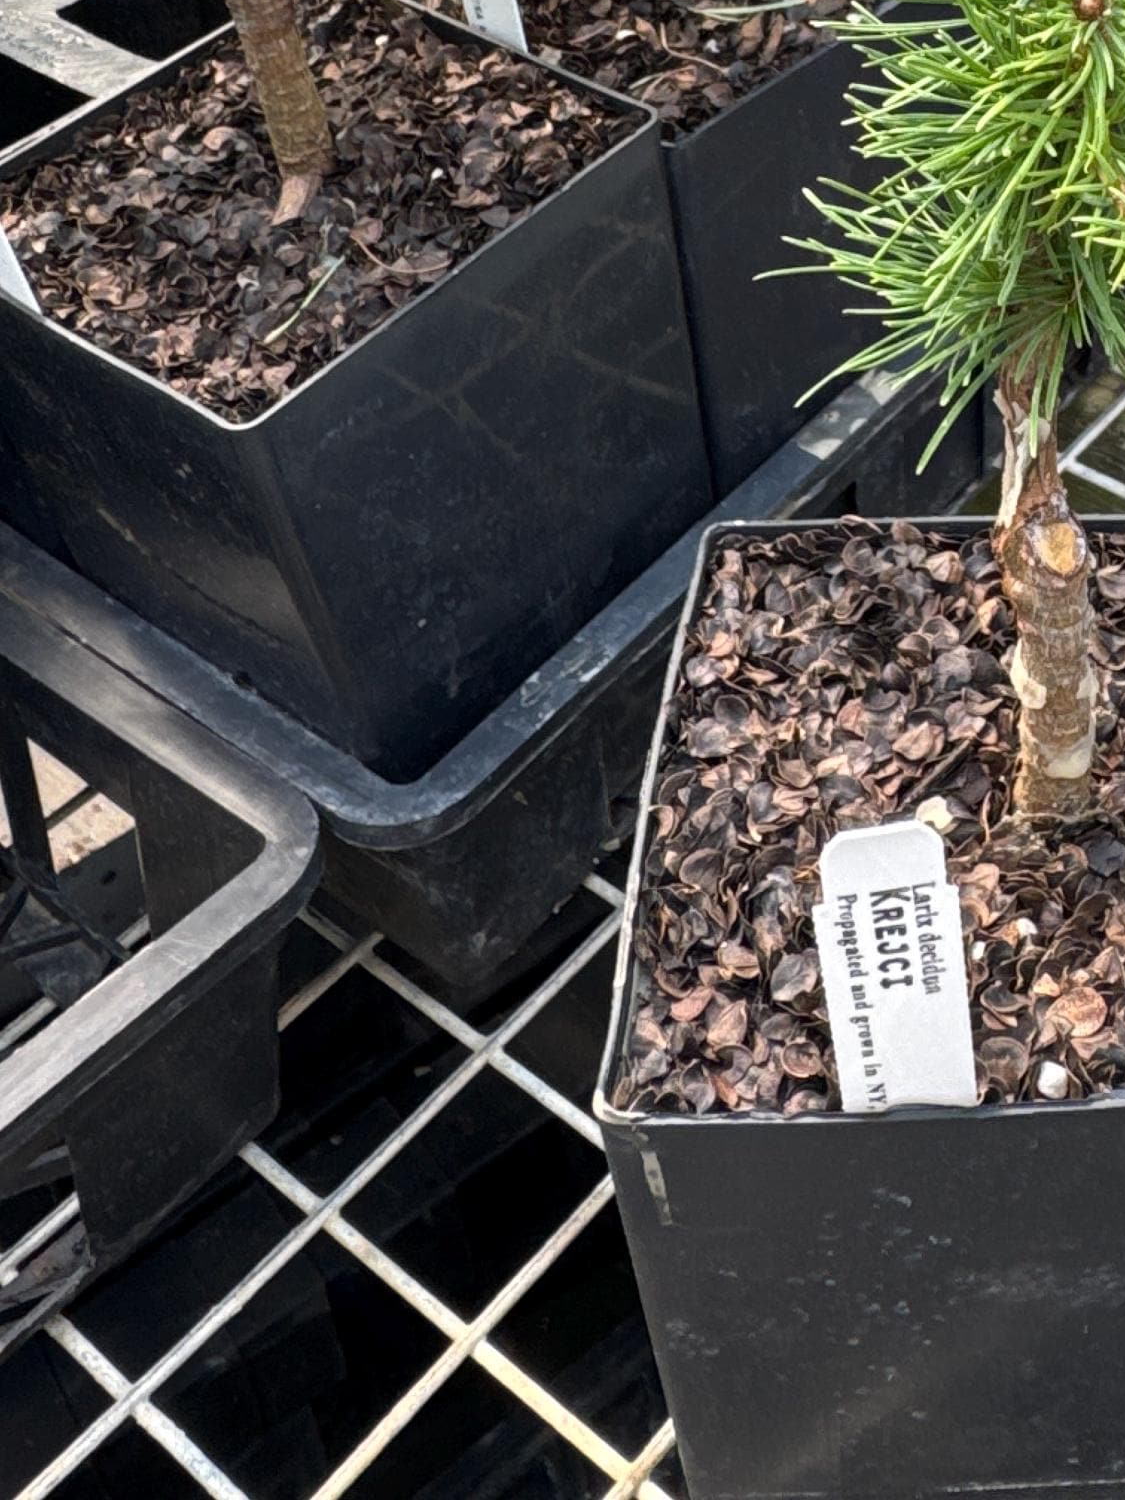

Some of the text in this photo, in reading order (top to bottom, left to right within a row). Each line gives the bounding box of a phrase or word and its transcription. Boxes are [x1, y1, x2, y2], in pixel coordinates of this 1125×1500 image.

[834, 894, 869, 978] Propagated
[869, 886, 914, 990] KREJCI
[912, 881, 946, 994] Larix decidua
[851, 984, 873, 1010] and
[850, 1016, 874, 1057] grown
[863, 1063, 879, 1077] in
